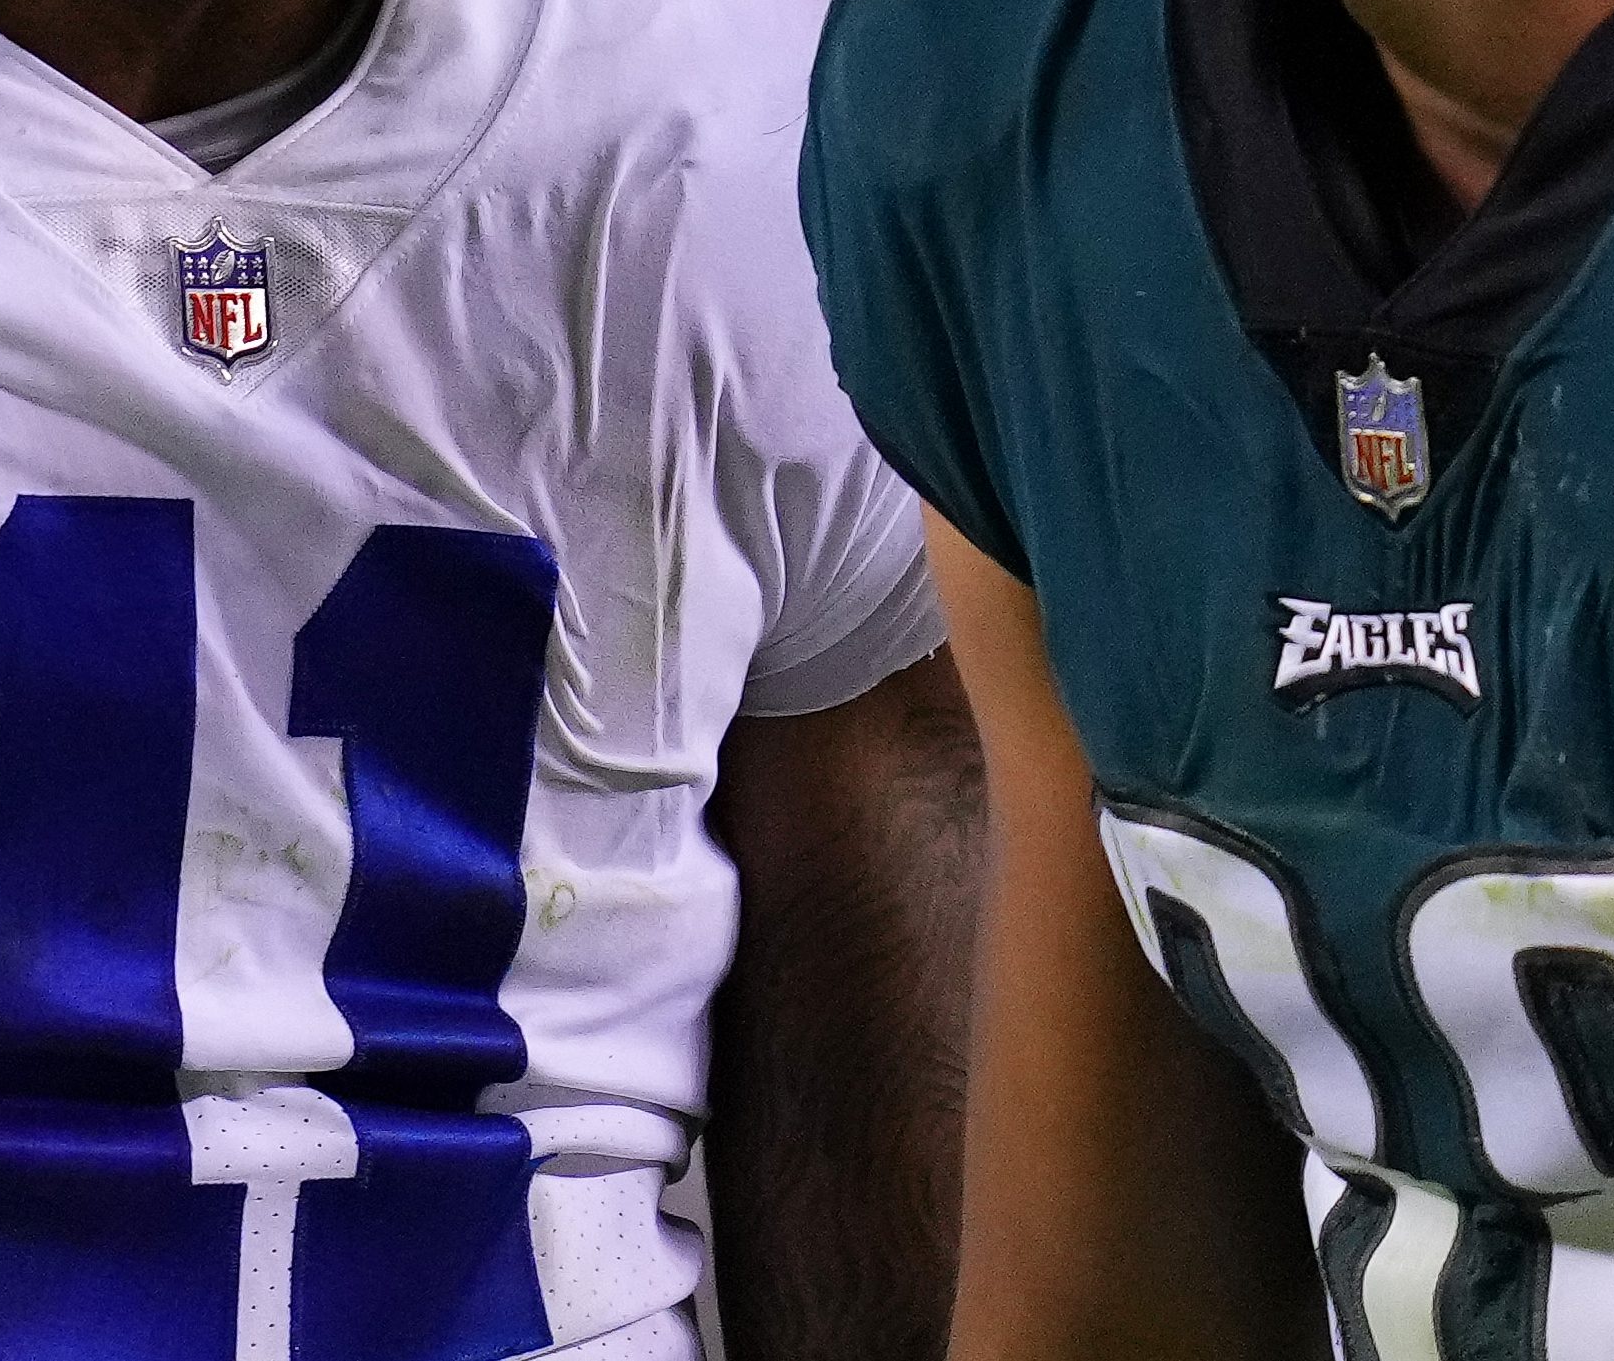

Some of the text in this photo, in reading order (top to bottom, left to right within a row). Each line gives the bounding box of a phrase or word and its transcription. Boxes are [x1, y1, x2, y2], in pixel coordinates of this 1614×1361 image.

[188, 292, 263, 351] NFL
[1355, 433, 1414, 491] NFL
[1274, 596, 1481, 698] EAGLES
